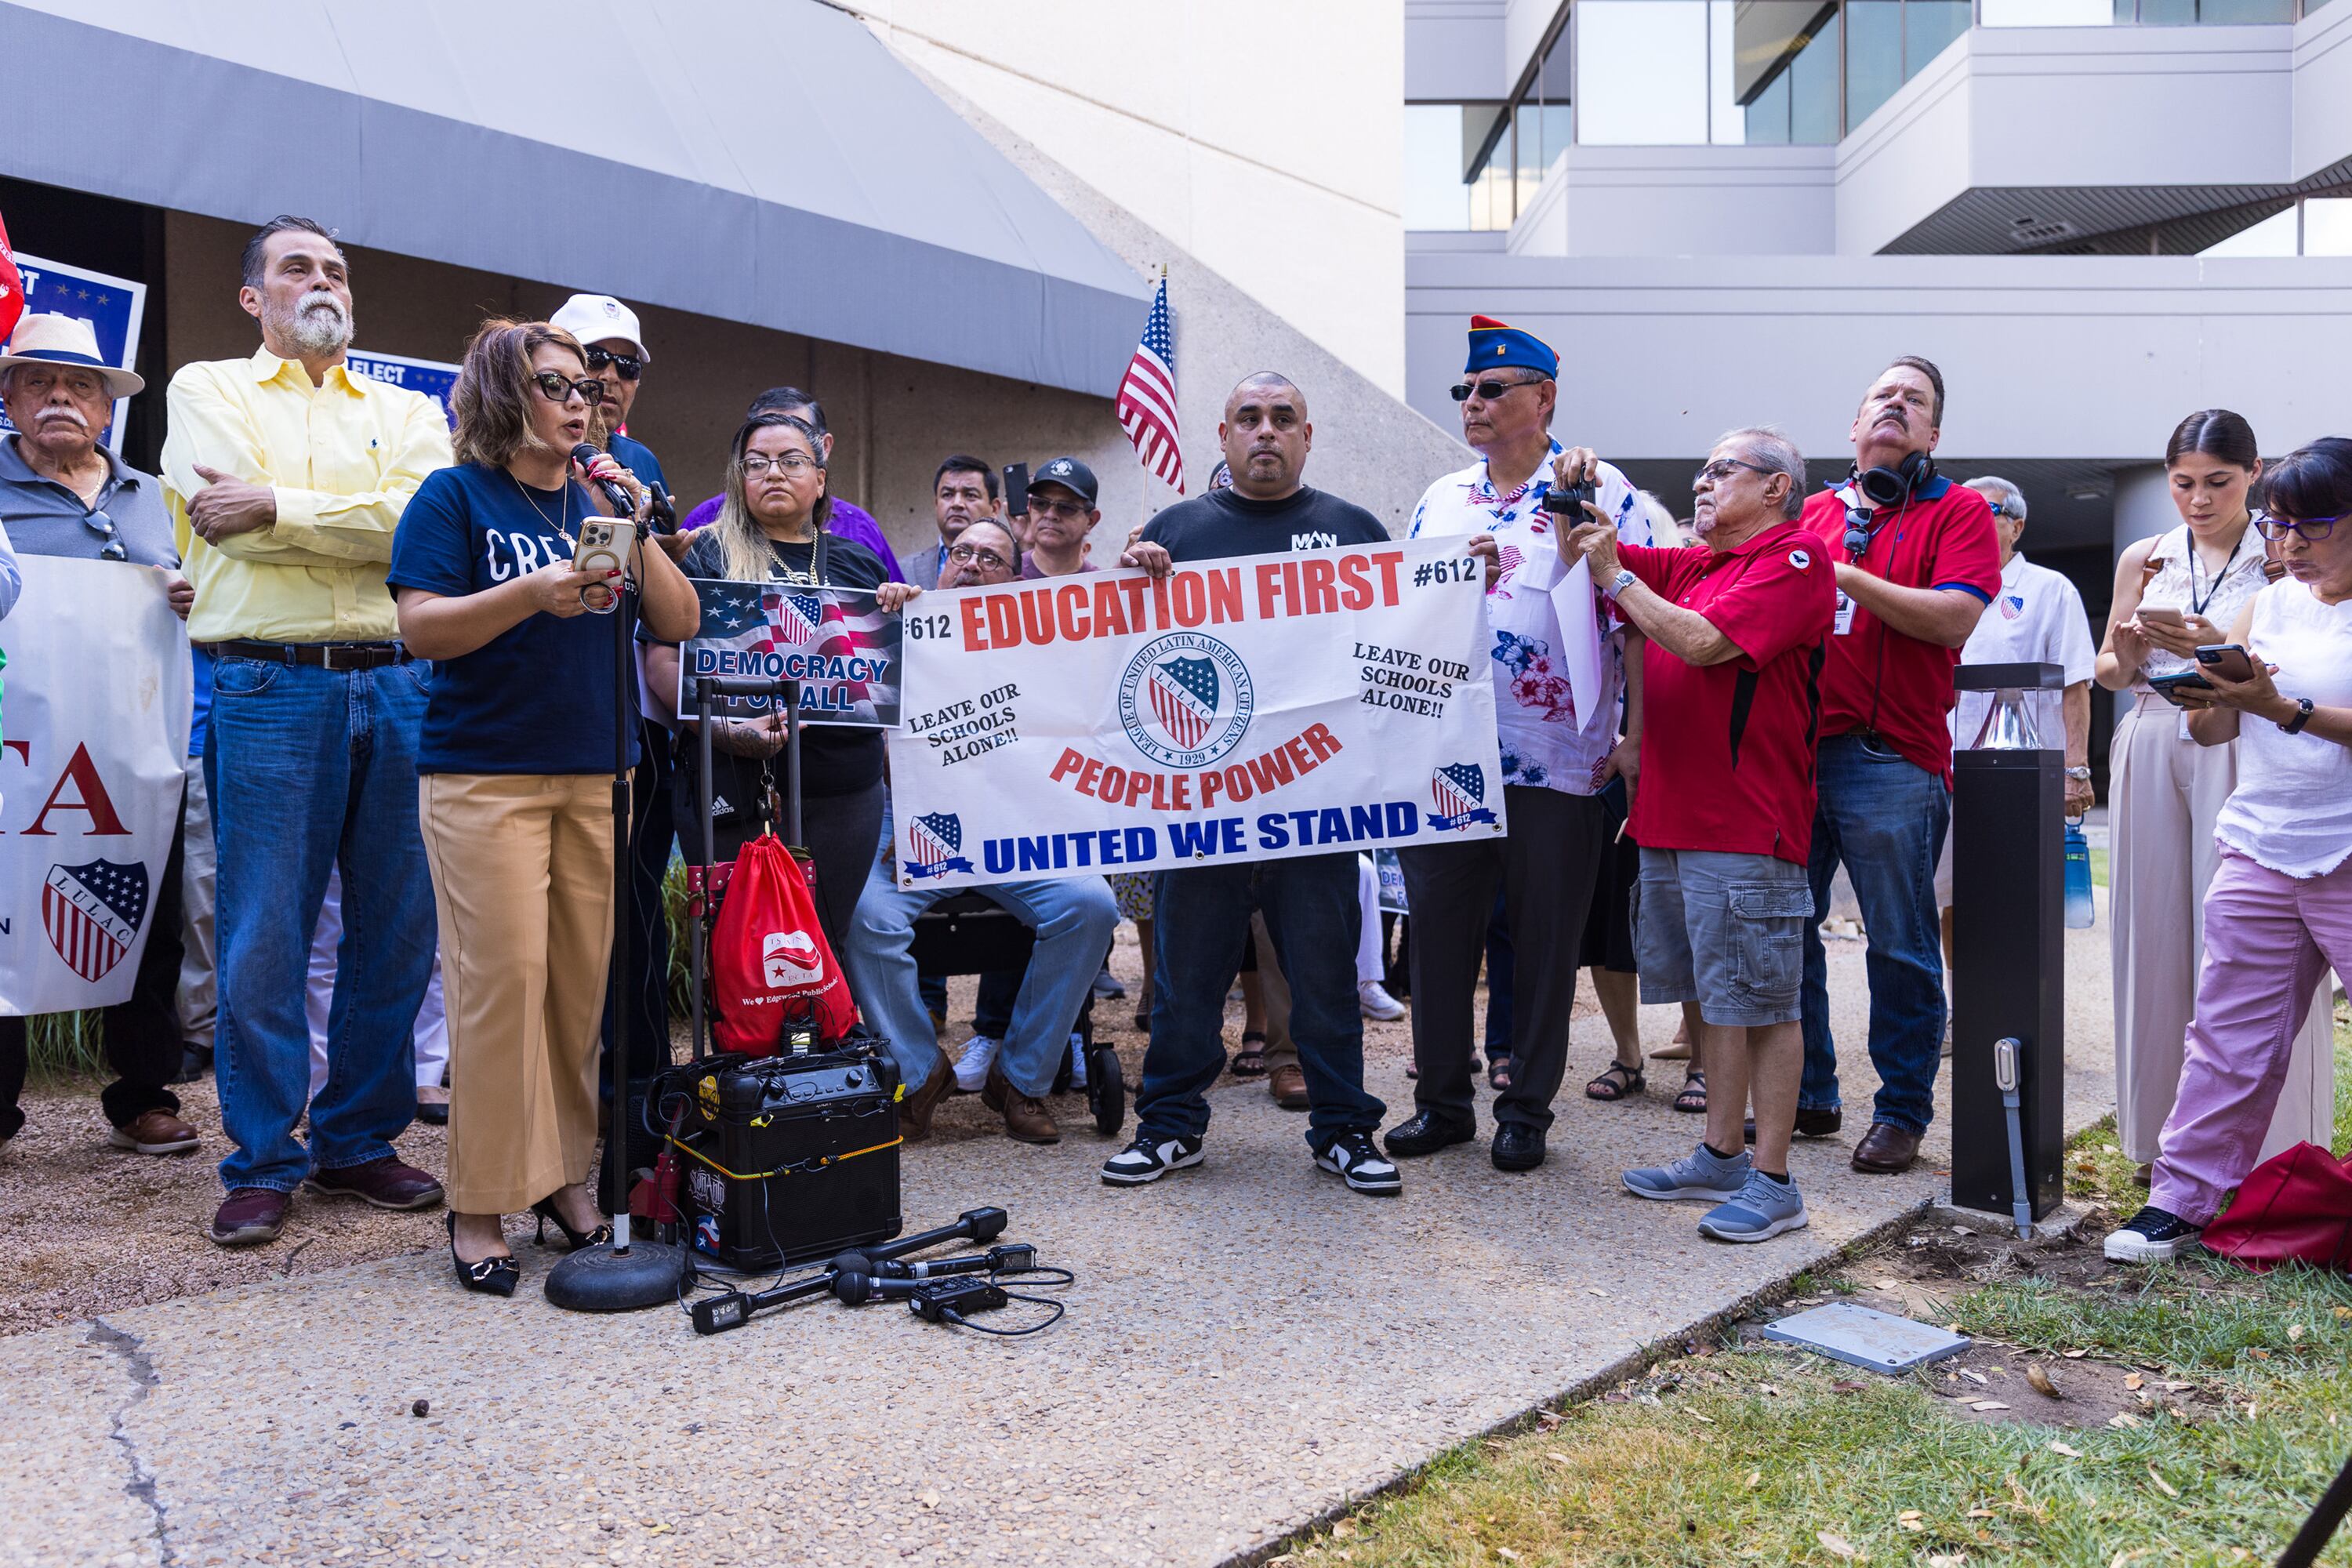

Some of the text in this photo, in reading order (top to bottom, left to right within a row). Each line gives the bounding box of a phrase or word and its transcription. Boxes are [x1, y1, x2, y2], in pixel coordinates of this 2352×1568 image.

[352, 360, 405, 384] ELECT
[486, 528, 579, 581] CRE
[1291, 530, 1337, 551] MAN
[1414, 558, 1476, 587] #612
[784, 601, 814, 630] LULAC
[960, 551, 1403, 652] EDUCATION FIRST
[696, 648, 888, 683] DEMOCRACY
[1352, 642, 1470, 681] LEAVE OUR
[798, 685, 855, 712] ALL
[1122, 635, 1250, 756] LEAGUE OF UNITED LATIN AMERICAN CITIZENS
[1156, 672, 1210, 718] LULAC
[1361, 666, 1452, 699] SCHOOLS
[908, 683, 1021, 734] LEAVE OUR
[1360, 688, 1443, 718] ALONE!!
[927, 706, 1016, 748] SCHOOLS
[942, 728, 1019, 767] ALONE!!
[1179, 753, 1206, 765] 1929
[1049, 722, 1344, 811] PEOPLE POWER
[1437, 774, 1478, 808] LULAC
[712, 807, 735, 816] didas
[1450, 814, 1472, 826] #612
[915, 822, 954, 857] LULAC
[982, 801, 1419, 875] UNITED WE STAND
[926, 862, 947, 874] #612
[55, 877, 130, 941] LULAC
[802, 987, 824, 996] Public
